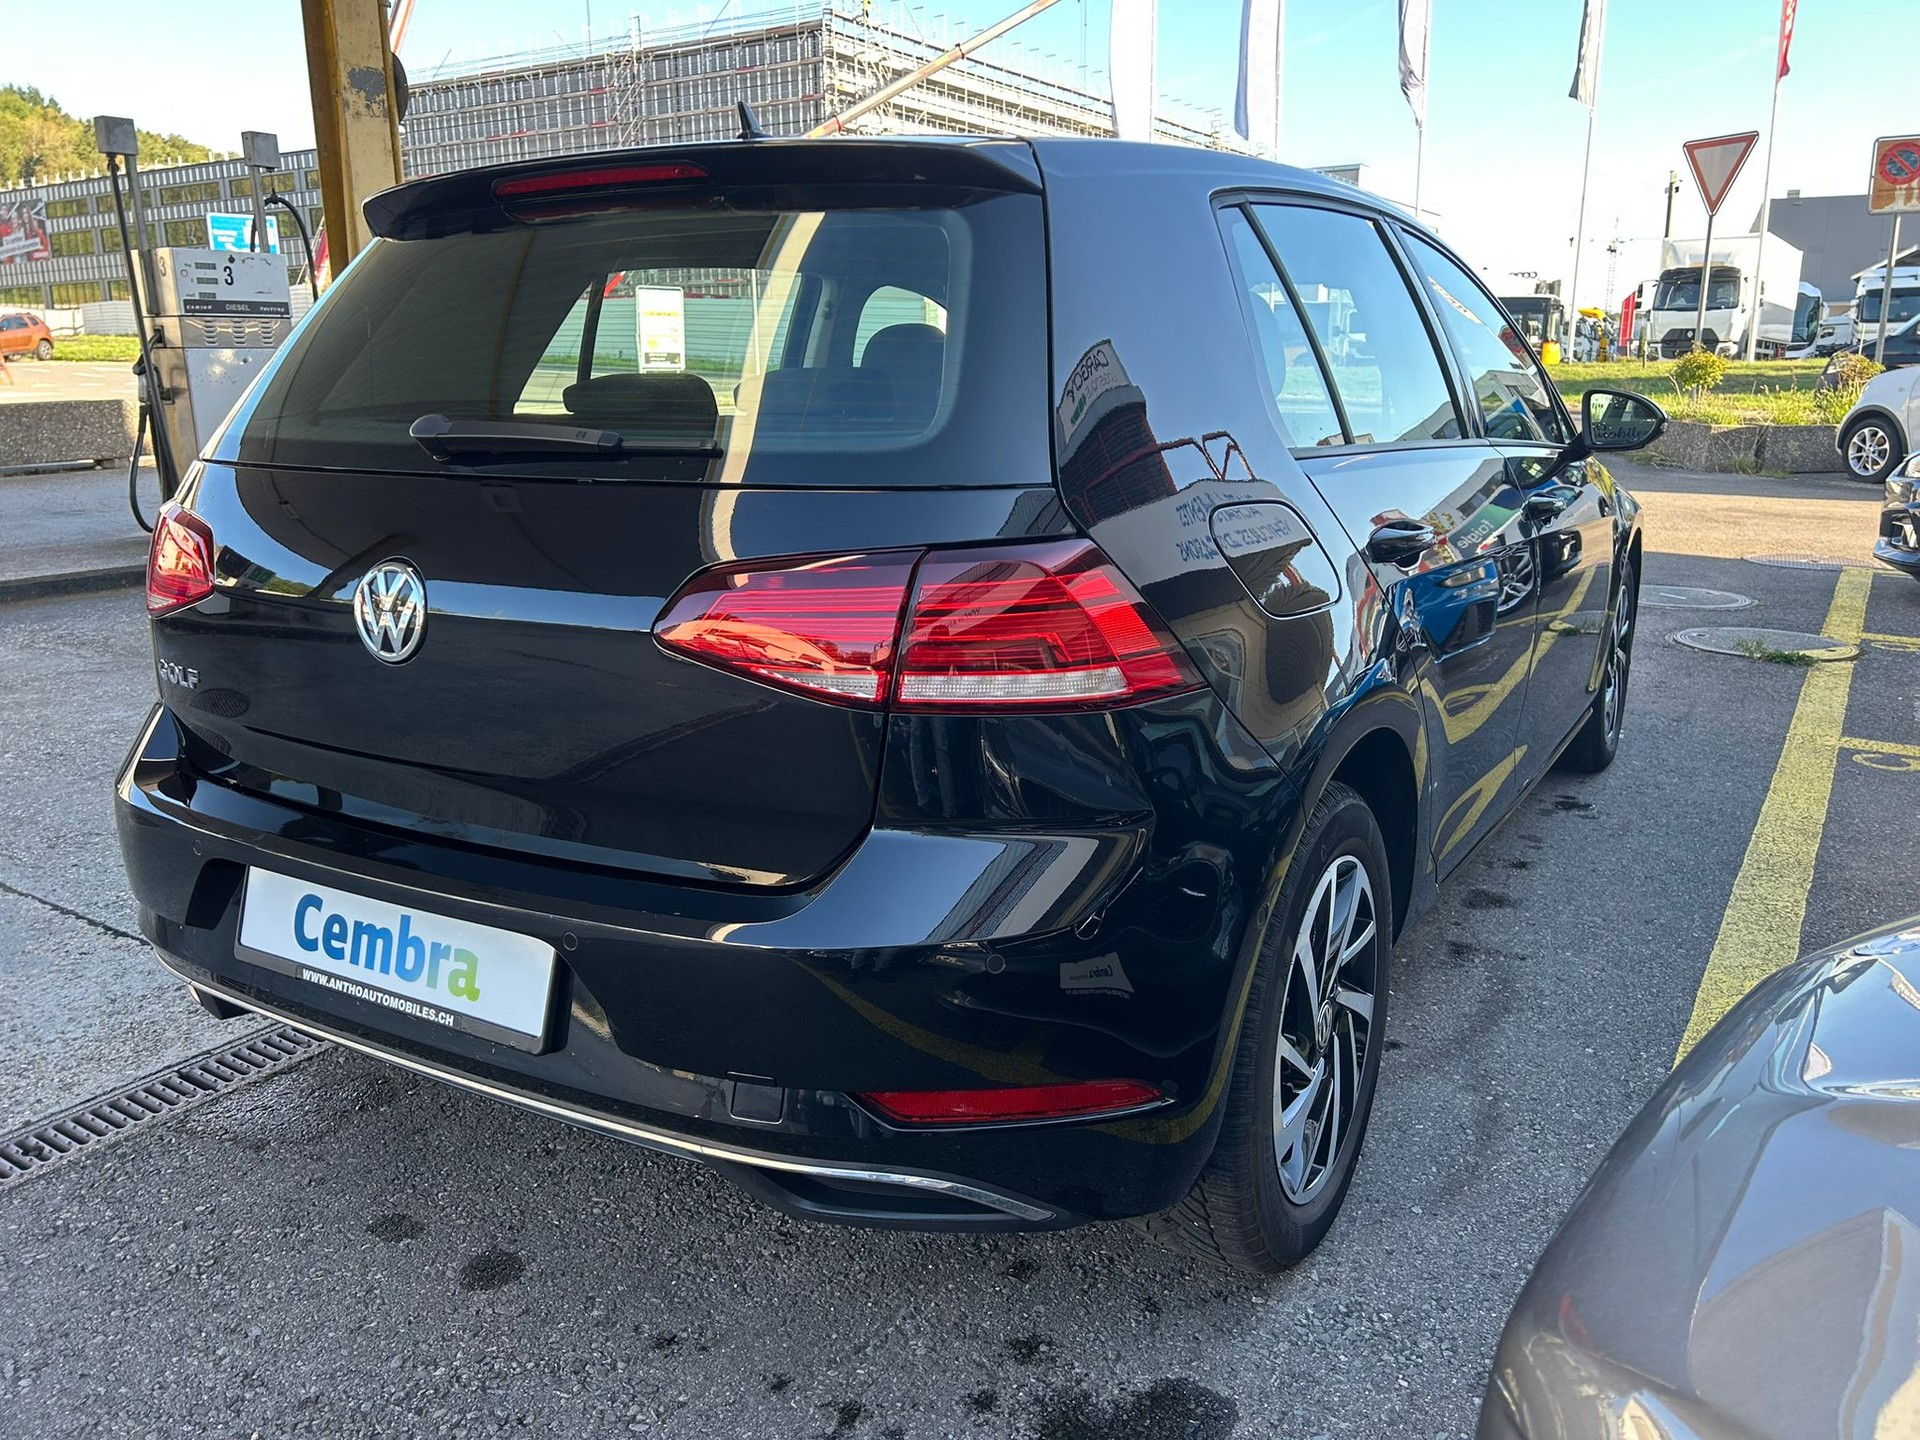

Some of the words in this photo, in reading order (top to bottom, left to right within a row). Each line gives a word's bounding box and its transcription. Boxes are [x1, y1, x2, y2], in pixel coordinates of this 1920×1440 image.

[159, 256, 167, 277] 3
[223, 265, 234, 286] 3
[225, 303, 251, 312] DIESEL
[158, 658, 199, 690] GOLF
[293, 893, 481, 1002] Cembra
[302, 968, 455, 1027] WWW.ANTHOAUTOMOBILES.CH
